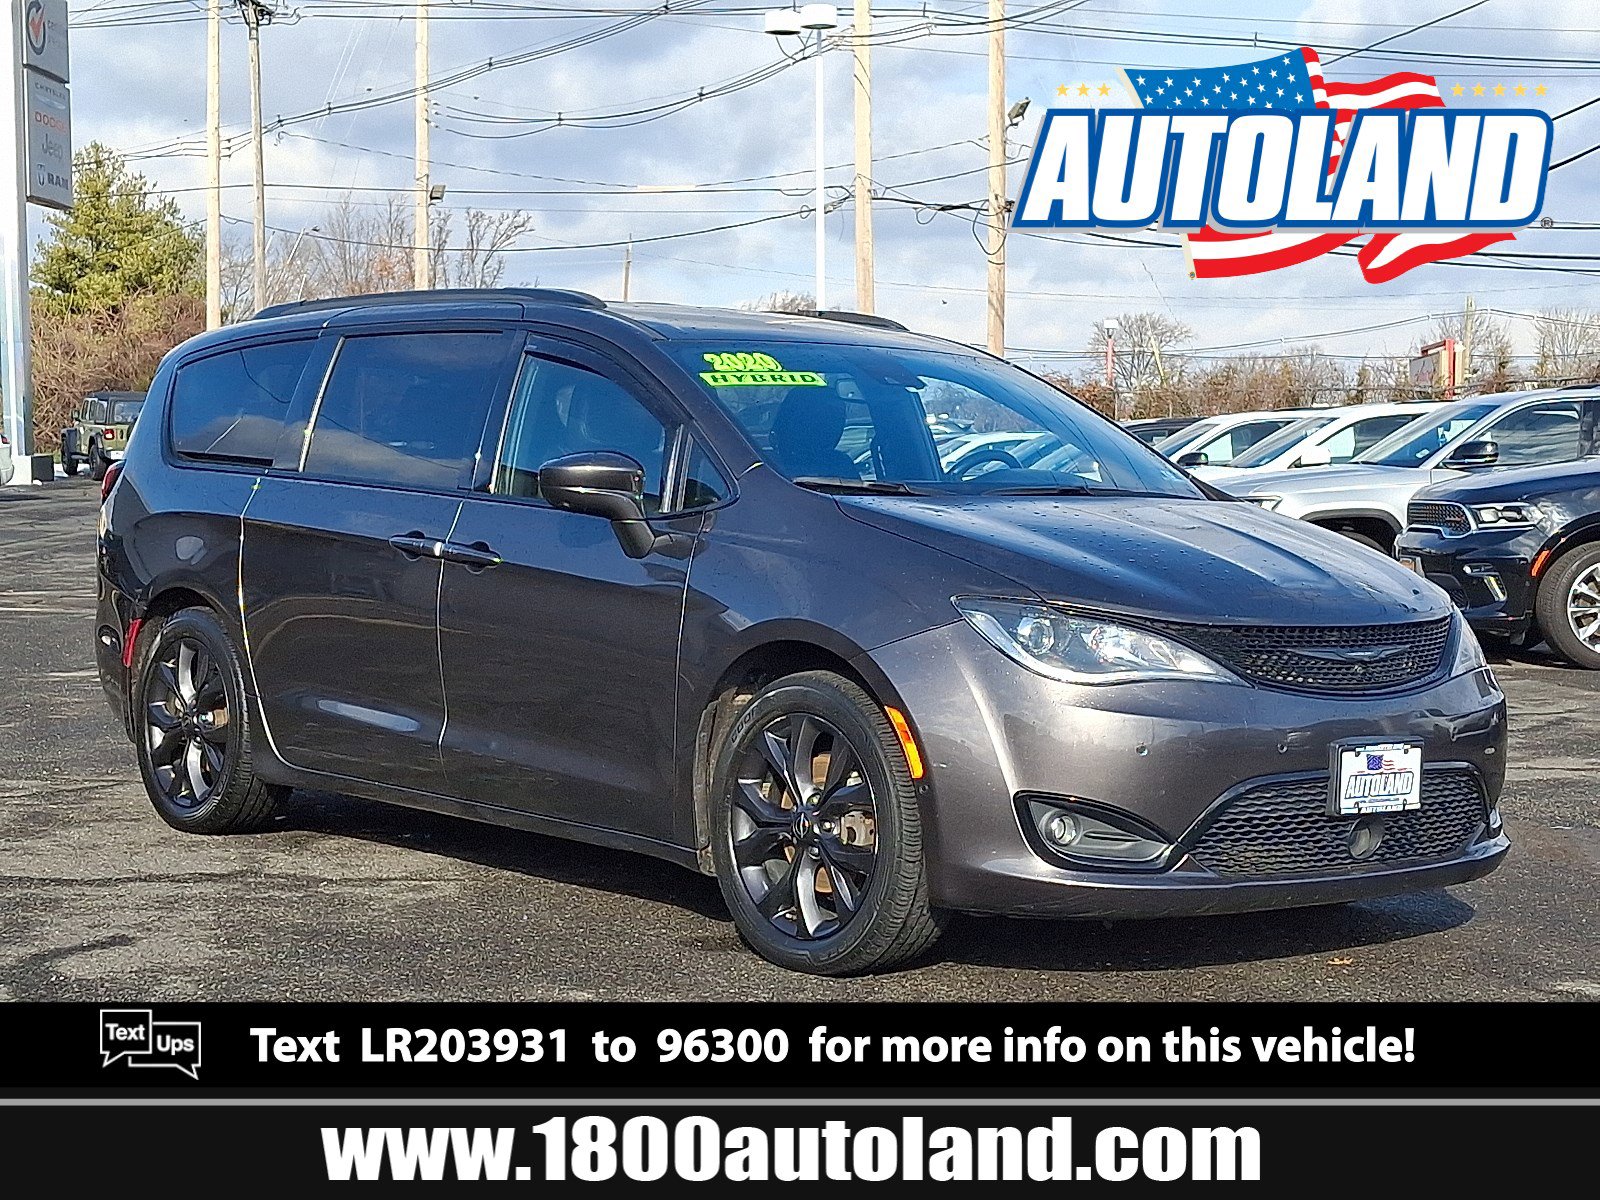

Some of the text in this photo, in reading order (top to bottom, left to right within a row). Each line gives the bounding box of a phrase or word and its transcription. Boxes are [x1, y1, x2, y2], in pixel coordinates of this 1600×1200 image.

[47, 172, 69, 190] RAM
[703, 352, 783, 372] 2020
[710, 374, 817, 384] HYBRID
[1344, 771, 1414, 800] AUTOLAND
